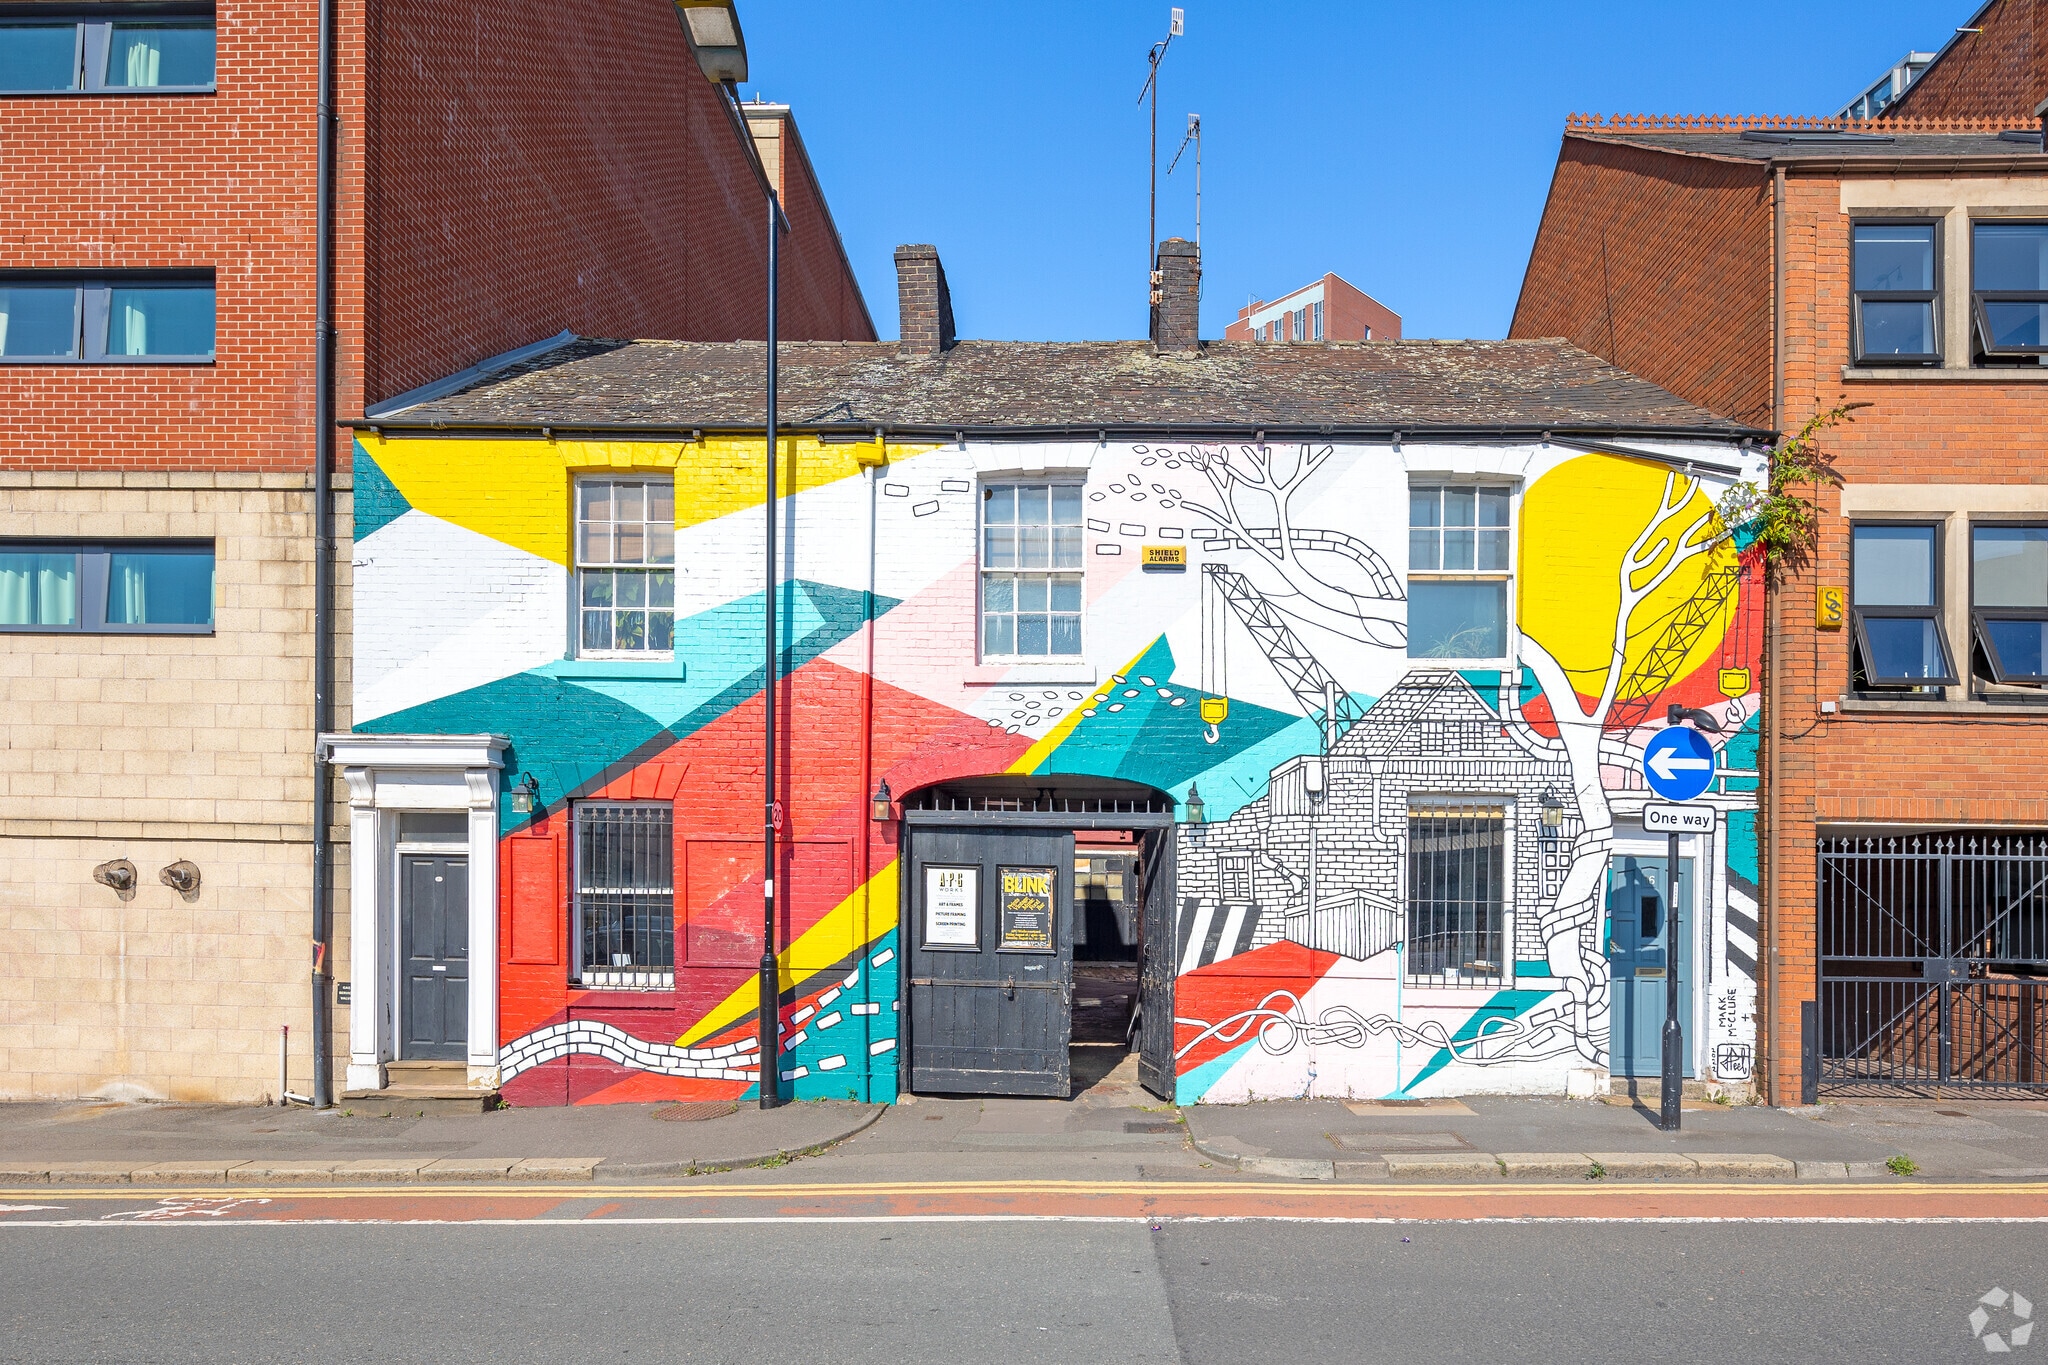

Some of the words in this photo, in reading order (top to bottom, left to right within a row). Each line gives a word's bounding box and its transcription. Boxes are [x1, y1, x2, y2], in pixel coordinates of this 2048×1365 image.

[774, 808, 782, 823] 20
[1650, 811, 1678, 824] One
[1683, 815, 1710, 828] way
[1004, 875, 1048, 894] BLINK
[1718, 997, 1726, 1027] MARK
